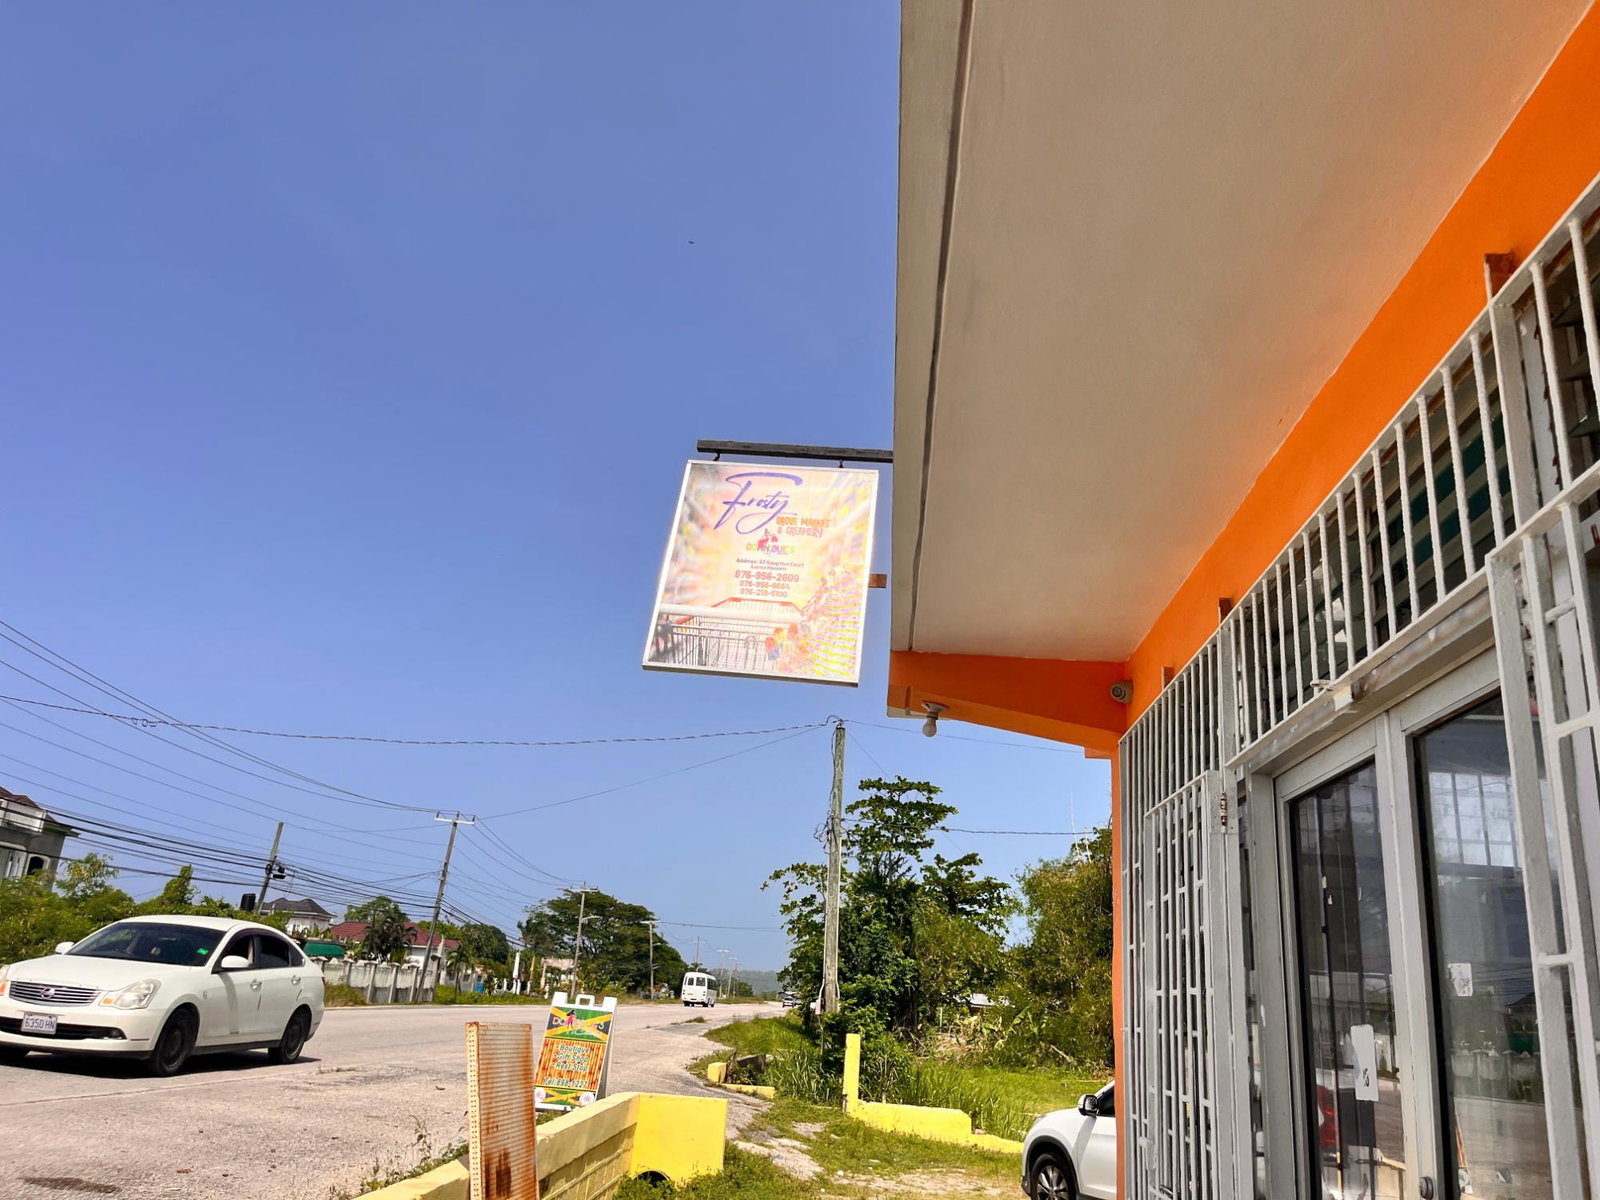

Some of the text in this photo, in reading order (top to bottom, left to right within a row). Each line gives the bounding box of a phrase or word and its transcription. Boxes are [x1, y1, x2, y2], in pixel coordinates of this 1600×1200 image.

[45, 1019, 56, 1030] HN
[559, 1044, 590, 1054] Boutique
[557, 1053, 589, 1063] Gift Shop
[556, 1062, 588, 1072] Rest Stop
